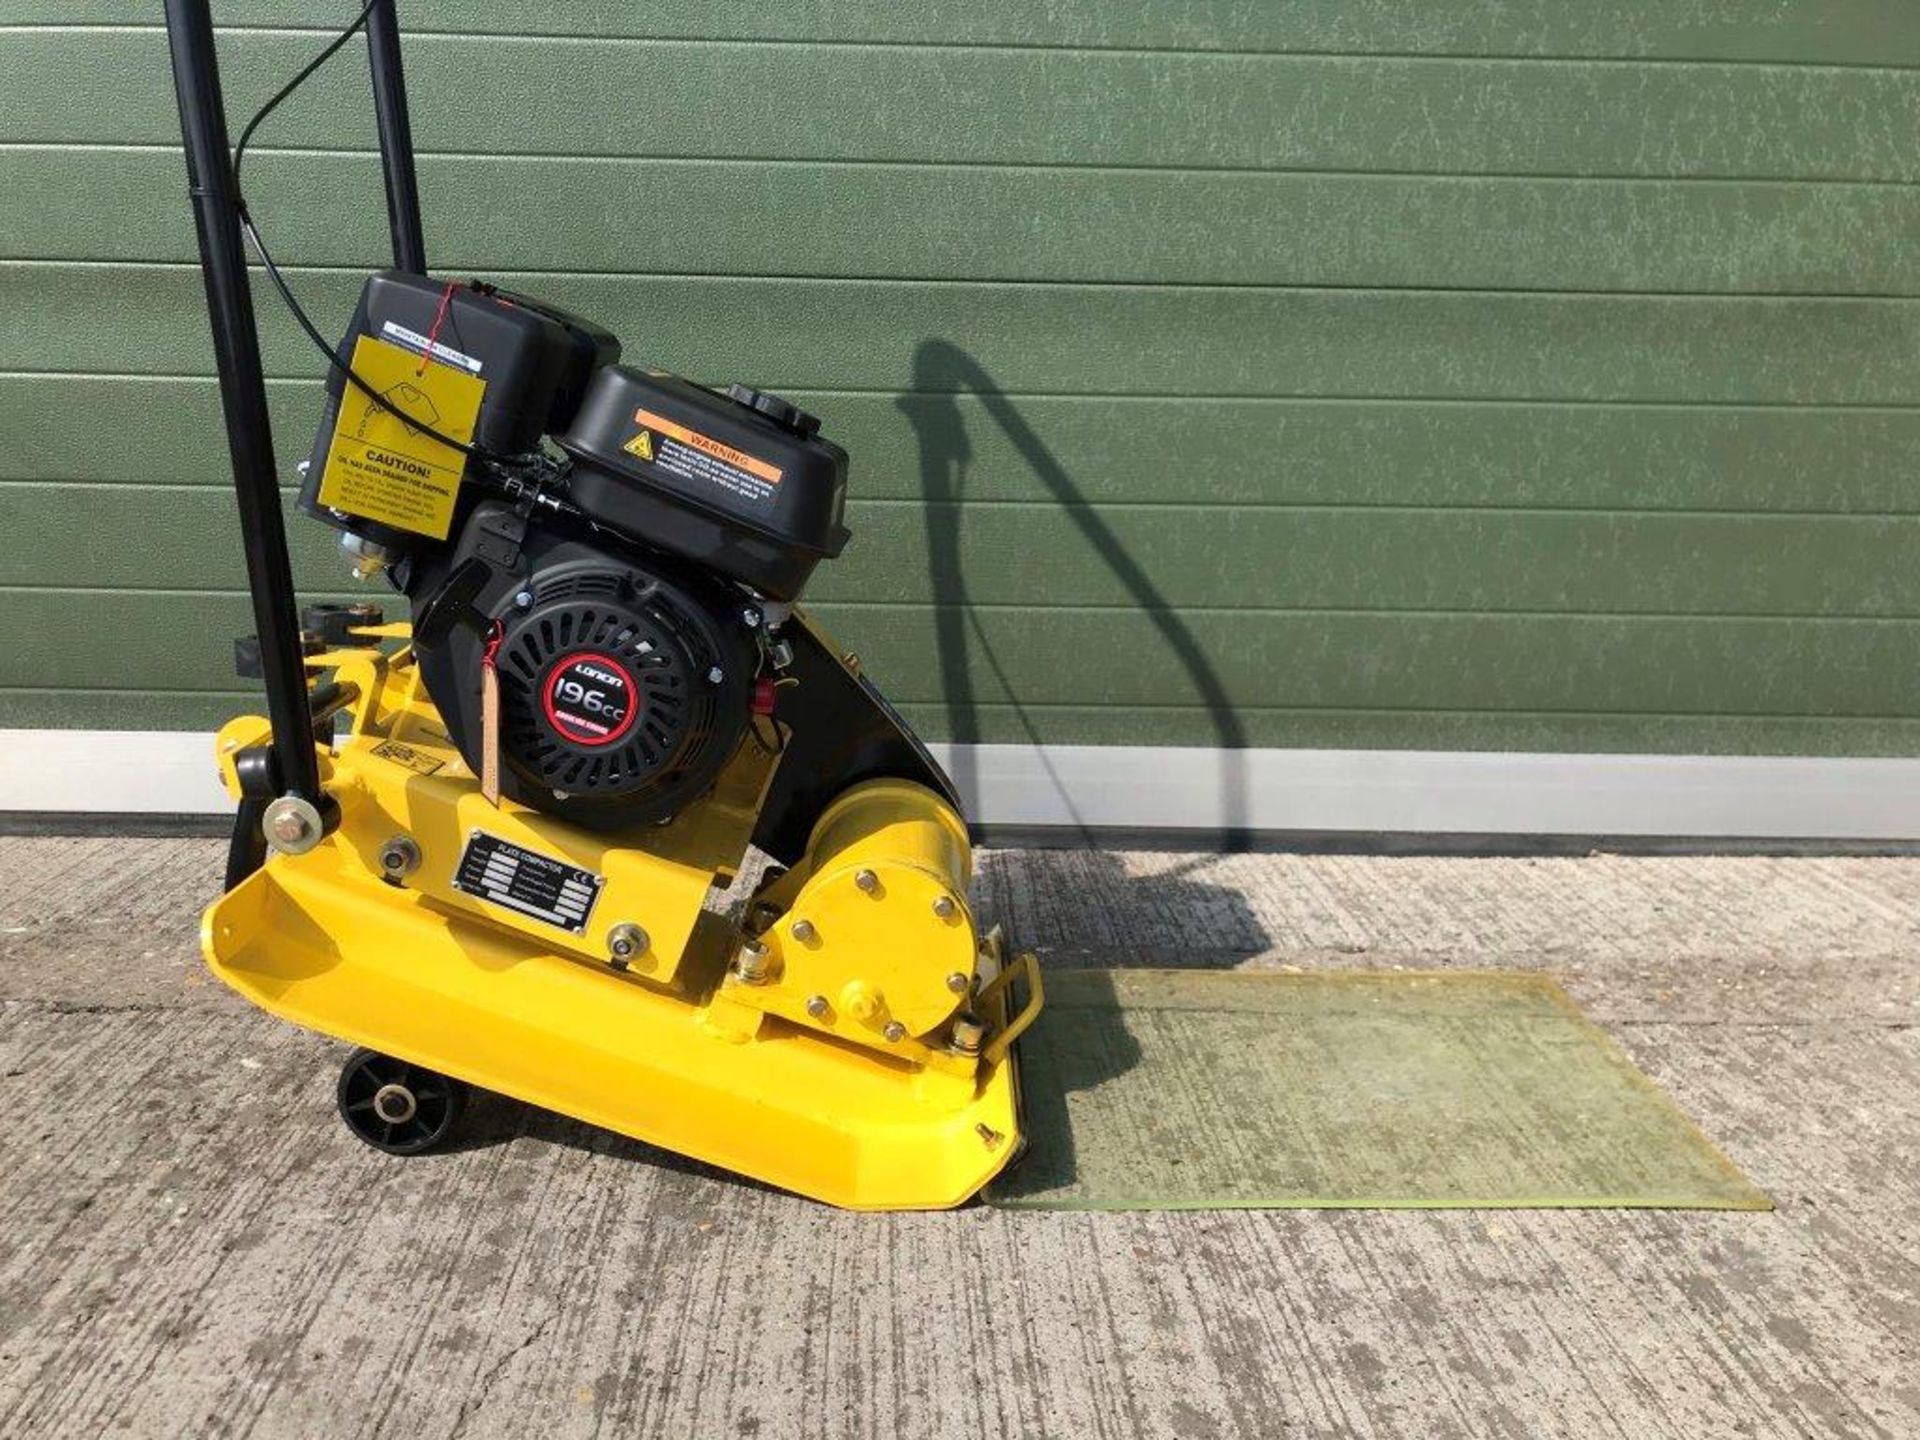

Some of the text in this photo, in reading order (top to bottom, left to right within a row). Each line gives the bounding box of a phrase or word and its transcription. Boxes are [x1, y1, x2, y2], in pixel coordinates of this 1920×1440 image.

[364, 448, 432, 478] CAUTION!
[688, 434, 749, 466] WARNING
[497, 843, 520, 857] PLATE
[519, 852, 564, 874] COMPACTOR
